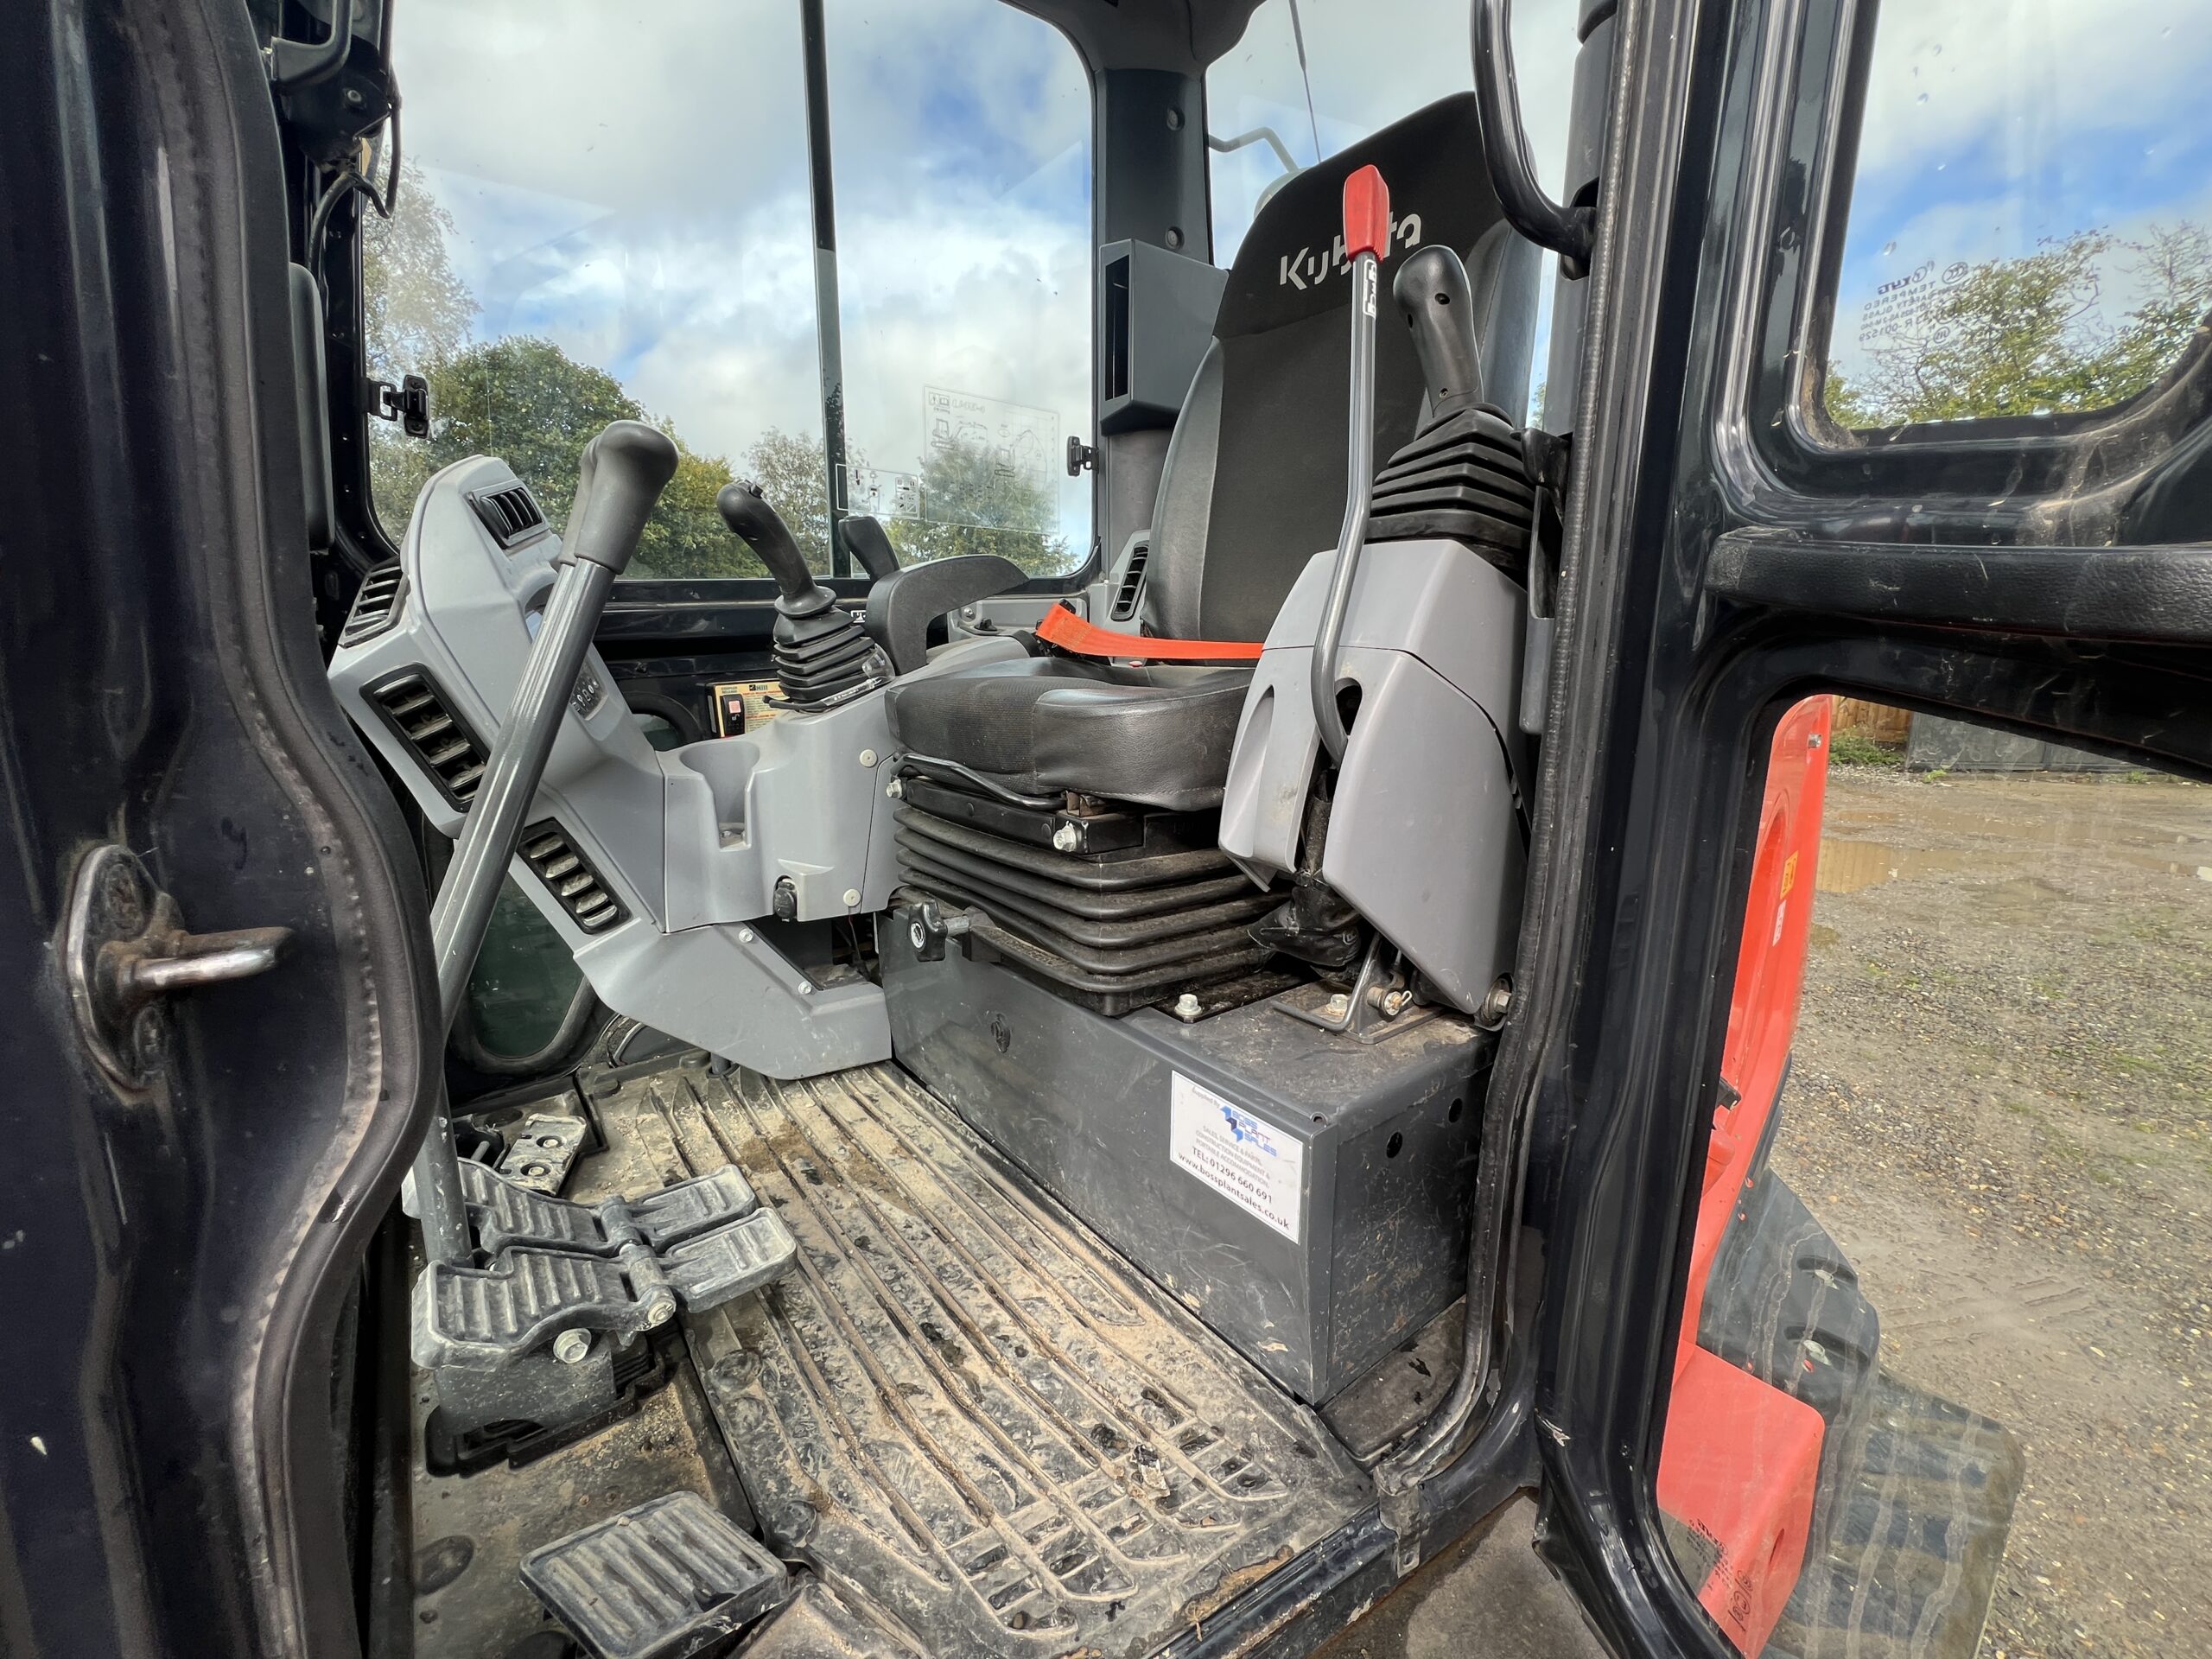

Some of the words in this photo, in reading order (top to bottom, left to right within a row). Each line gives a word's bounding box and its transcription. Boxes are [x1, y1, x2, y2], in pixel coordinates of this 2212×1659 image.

[1280, 212, 1421, 290] Kubta
[1232, 1109, 1258, 1130] BOSS
[1238, 1120, 1271, 1147] PLANT
[1195, 1128, 1234, 1159] CONSTRUCTION
[1243, 1131, 1277, 1158] SALES
[1178, 1149, 1290, 1232] www.bossplantsales.co.uk
[1192, 1145, 1209, 1165] TEL:
[1209, 1157, 1236, 1181] 01296
[1237, 1174, 1254, 1193] 660
[1255, 1185, 1273, 1205] 691
